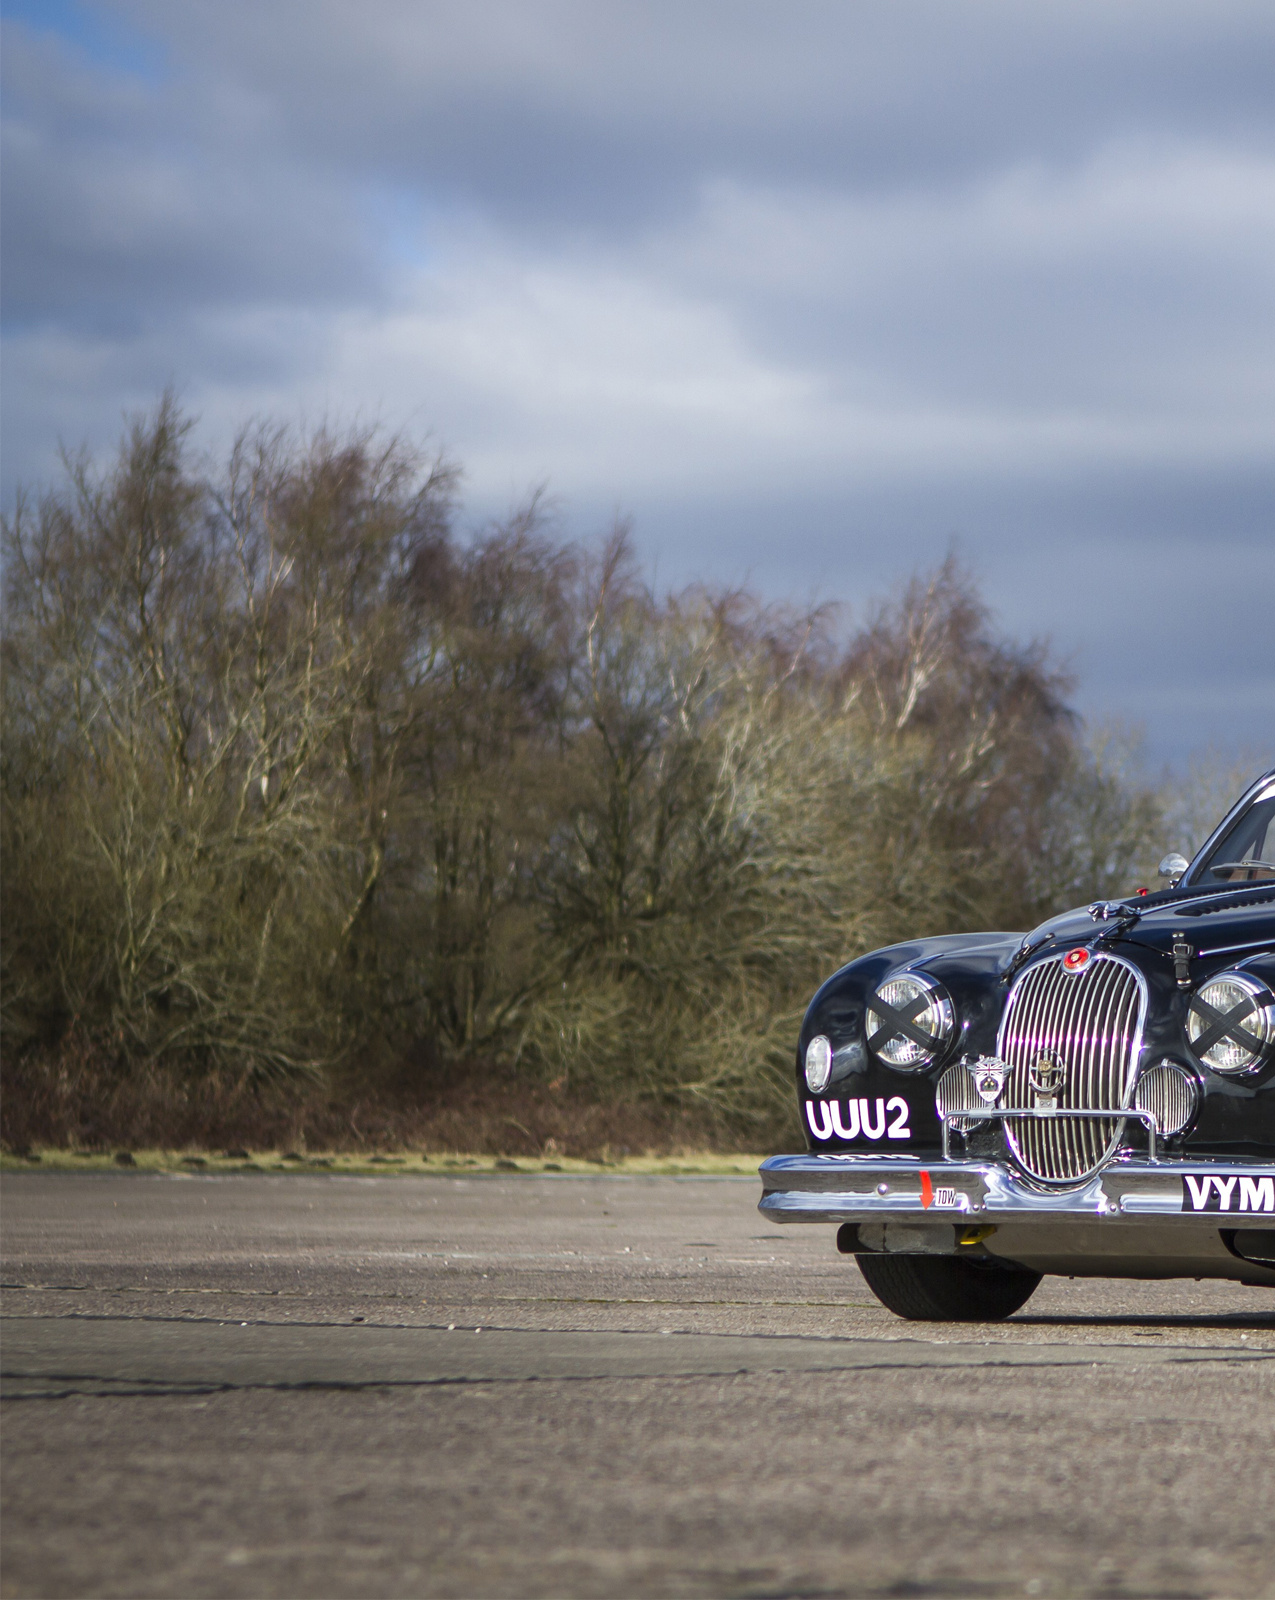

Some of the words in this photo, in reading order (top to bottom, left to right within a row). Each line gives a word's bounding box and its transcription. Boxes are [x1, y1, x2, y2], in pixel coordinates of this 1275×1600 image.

[805, 1096, 911, 1140] UUU2
[937, 1189, 956, 1205] TOW
[1184, 1176, 1275, 1212] VYM
